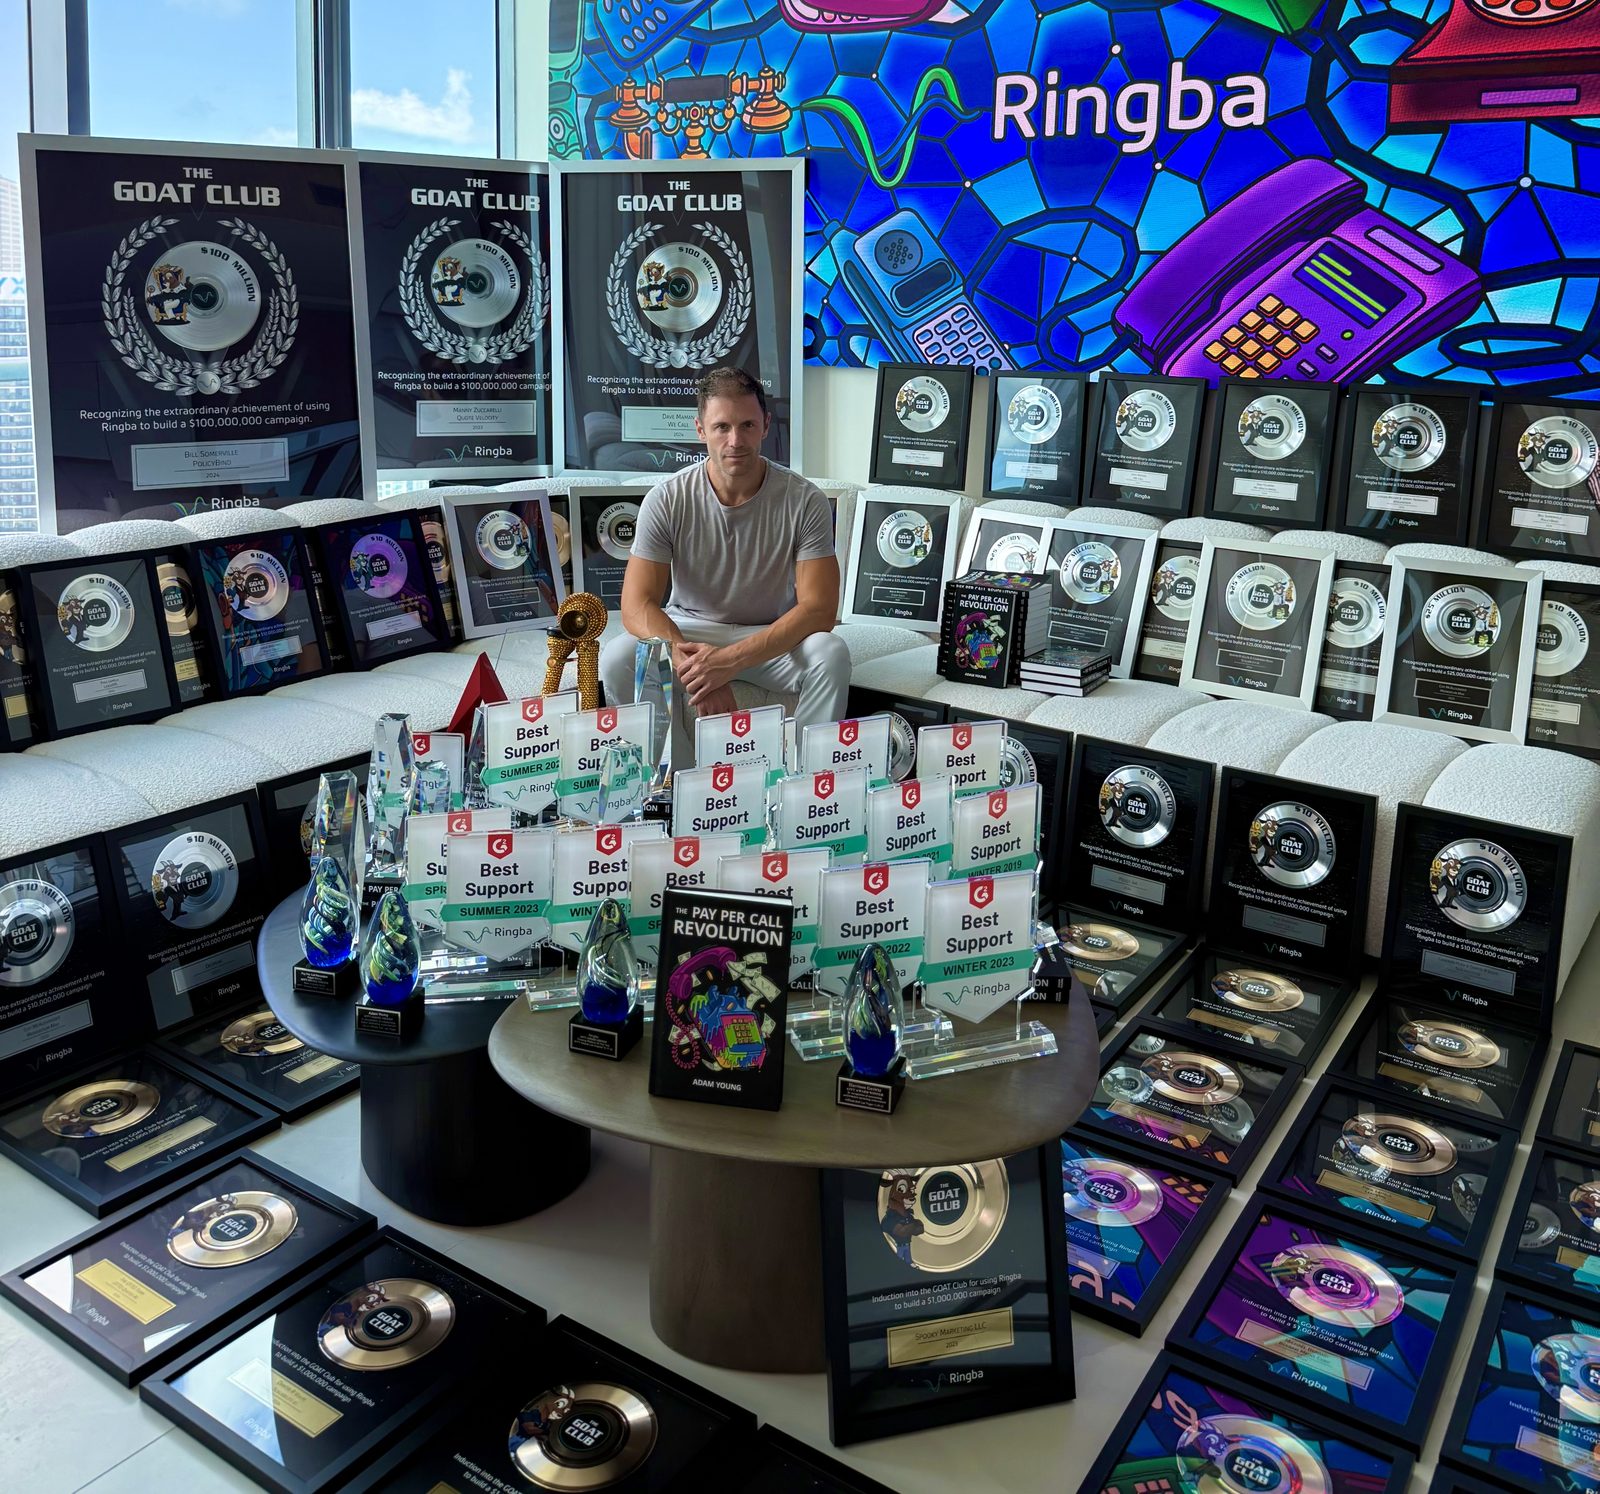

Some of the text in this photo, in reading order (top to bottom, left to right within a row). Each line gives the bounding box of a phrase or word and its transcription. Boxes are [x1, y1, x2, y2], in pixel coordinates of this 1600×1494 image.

[992, 61, 1267, 154] Ringba
[183, 167, 213, 180] THE
[465, 178, 489, 189] THE
[668, 181, 691, 191] THE
[113, 181, 281, 207] GOAT CLUB
[411, 188, 541, 212] GOAT CLUB
[617, 194, 743, 212] GOAT CLUB
[201, 246, 257, 303] $100 MILLION
[475, 243, 516, 290] $100 MILLION
[678, 246, 718, 292] $100 MILLION
[378, 371, 426, 381] Recognizing
[441, 372, 493, 381] extraordinary
[494, 372, 542, 380] achievement
[394, 382, 518, 391] Ringba build $100,000,000
[80, 401, 330, 421] Recognizing the extraordinary achievement using
[102, 414, 313, 433] Ringba to build $100,000,000 campaign.
[475, 446, 513, 459] Ringba
[675, 452, 709, 463] Ringb
[211, 496, 260, 510] Ringba
[1398, 518, 1419, 526] Ringba
[1545, 537, 1567, 547] Ringba
[960, 600, 1009, 613] REVOLUTION
[993, 597, 1009, 605] CALL
[87, 607, 106, 615] GOAT
[112, 702, 133, 710] Ringba
[1447, 709, 1473, 720] Ringba
[516, 724, 549, 741] Best
[725, 740, 755, 755] Best
[832, 748, 862, 764] Best
[946, 753, 976, 768] Best
[500, 760, 560, 779] SUMMER 202
[705, 794, 737, 811] Best
[1156, 779, 1174, 817] MILLION
[808, 802, 839, 819] Best
[692, 811, 749, 832] Support
[796, 818, 850, 840] Support
[896, 812, 926, 830] Best
[982, 821, 1011, 839] Best
[1313, 816, 1334, 856] MILLION
[886, 828, 937, 851] Support
[1280, 839, 1303, 850] GOAT
[186, 834, 234, 871] $10 MILLION
[971, 837, 1021, 861] Support
[1280, 846, 1302, 856] CLUB
[480, 863, 519, 877] Best
[589, 859, 628, 875] Best
[1003, 860, 1022, 872] 2019
[1479, 843, 1524, 897] $10 MILLION
[185, 870, 208, 884] GOAT
[187, 878, 208, 891] CLUB
[666, 871, 705, 886] Best
[1466, 876, 1491, 888] GOAT
[465, 881, 534, 898] Support
[1466, 884, 1490, 895] CLUB
[16, 883, 71, 923] $10 MILLION
[460, 904, 539, 916] SUMMER 2023
[856, 898, 894, 916] Best
[1123, 903, 1144, 915] Ringba
[676, 906, 783, 929] THE PAY PER CALL
[961, 912, 999, 931] Best
[11, 923, 37, 938] GOAT
[494, 926, 533, 940] Ringba
[673, 919, 783, 947] REVOLUTION
[840, 917, 909, 939] Support
[13, 932, 38, 946] CLUB
[946, 931, 1013, 953] Support
[1405, 924, 1539, 963] Recognizing using
[1279, 945, 1302, 958] Ringba
[943, 957, 1015, 976] WINTER 2023
[217, 982, 241, 997] Ringba
[790, 981, 813, 990] CALL
[973, 983, 1010, 997] Ringba
[1462, 993, 1488, 1007] Ringba
[45, 1046, 73, 1063] Ringba
[692, 1078, 742, 1092] ADAM YOUNG
[928, 1187, 960, 1202] GOAT
[929, 1199, 960, 1214] CLUB
[1365, 1208, 1397, 1224] Ringba
[216, 1224, 239, 1238] CLUB
[224, 1218, 248, 1233] GOAT
[872, 1273, 1022, 1304] Induction into the GOAT Club for using Ringba
[1319, 1279, 1351, 1295] CLUB
[1322, 1273, 1355, 1289] GOAT
[903, 1286, 1001, 1309] build $1,000,000 campaign
[368, 1318, 395, 1335] CLUB
[377, 1311, 404, 1329] GOAT
[949, 1369, 984, 1384] Ringba
[1291, 1371, 1328, 1391] Ringba
[564, 1426, 596, 1447] CLUB
[572, 1418, 604, 1439] GOAT
[453, 1452, 481, 1473] Induction
[1235, 1456, 1273, 1475] GOAT
[1232, 1464, 1269, 1486] CLUB
